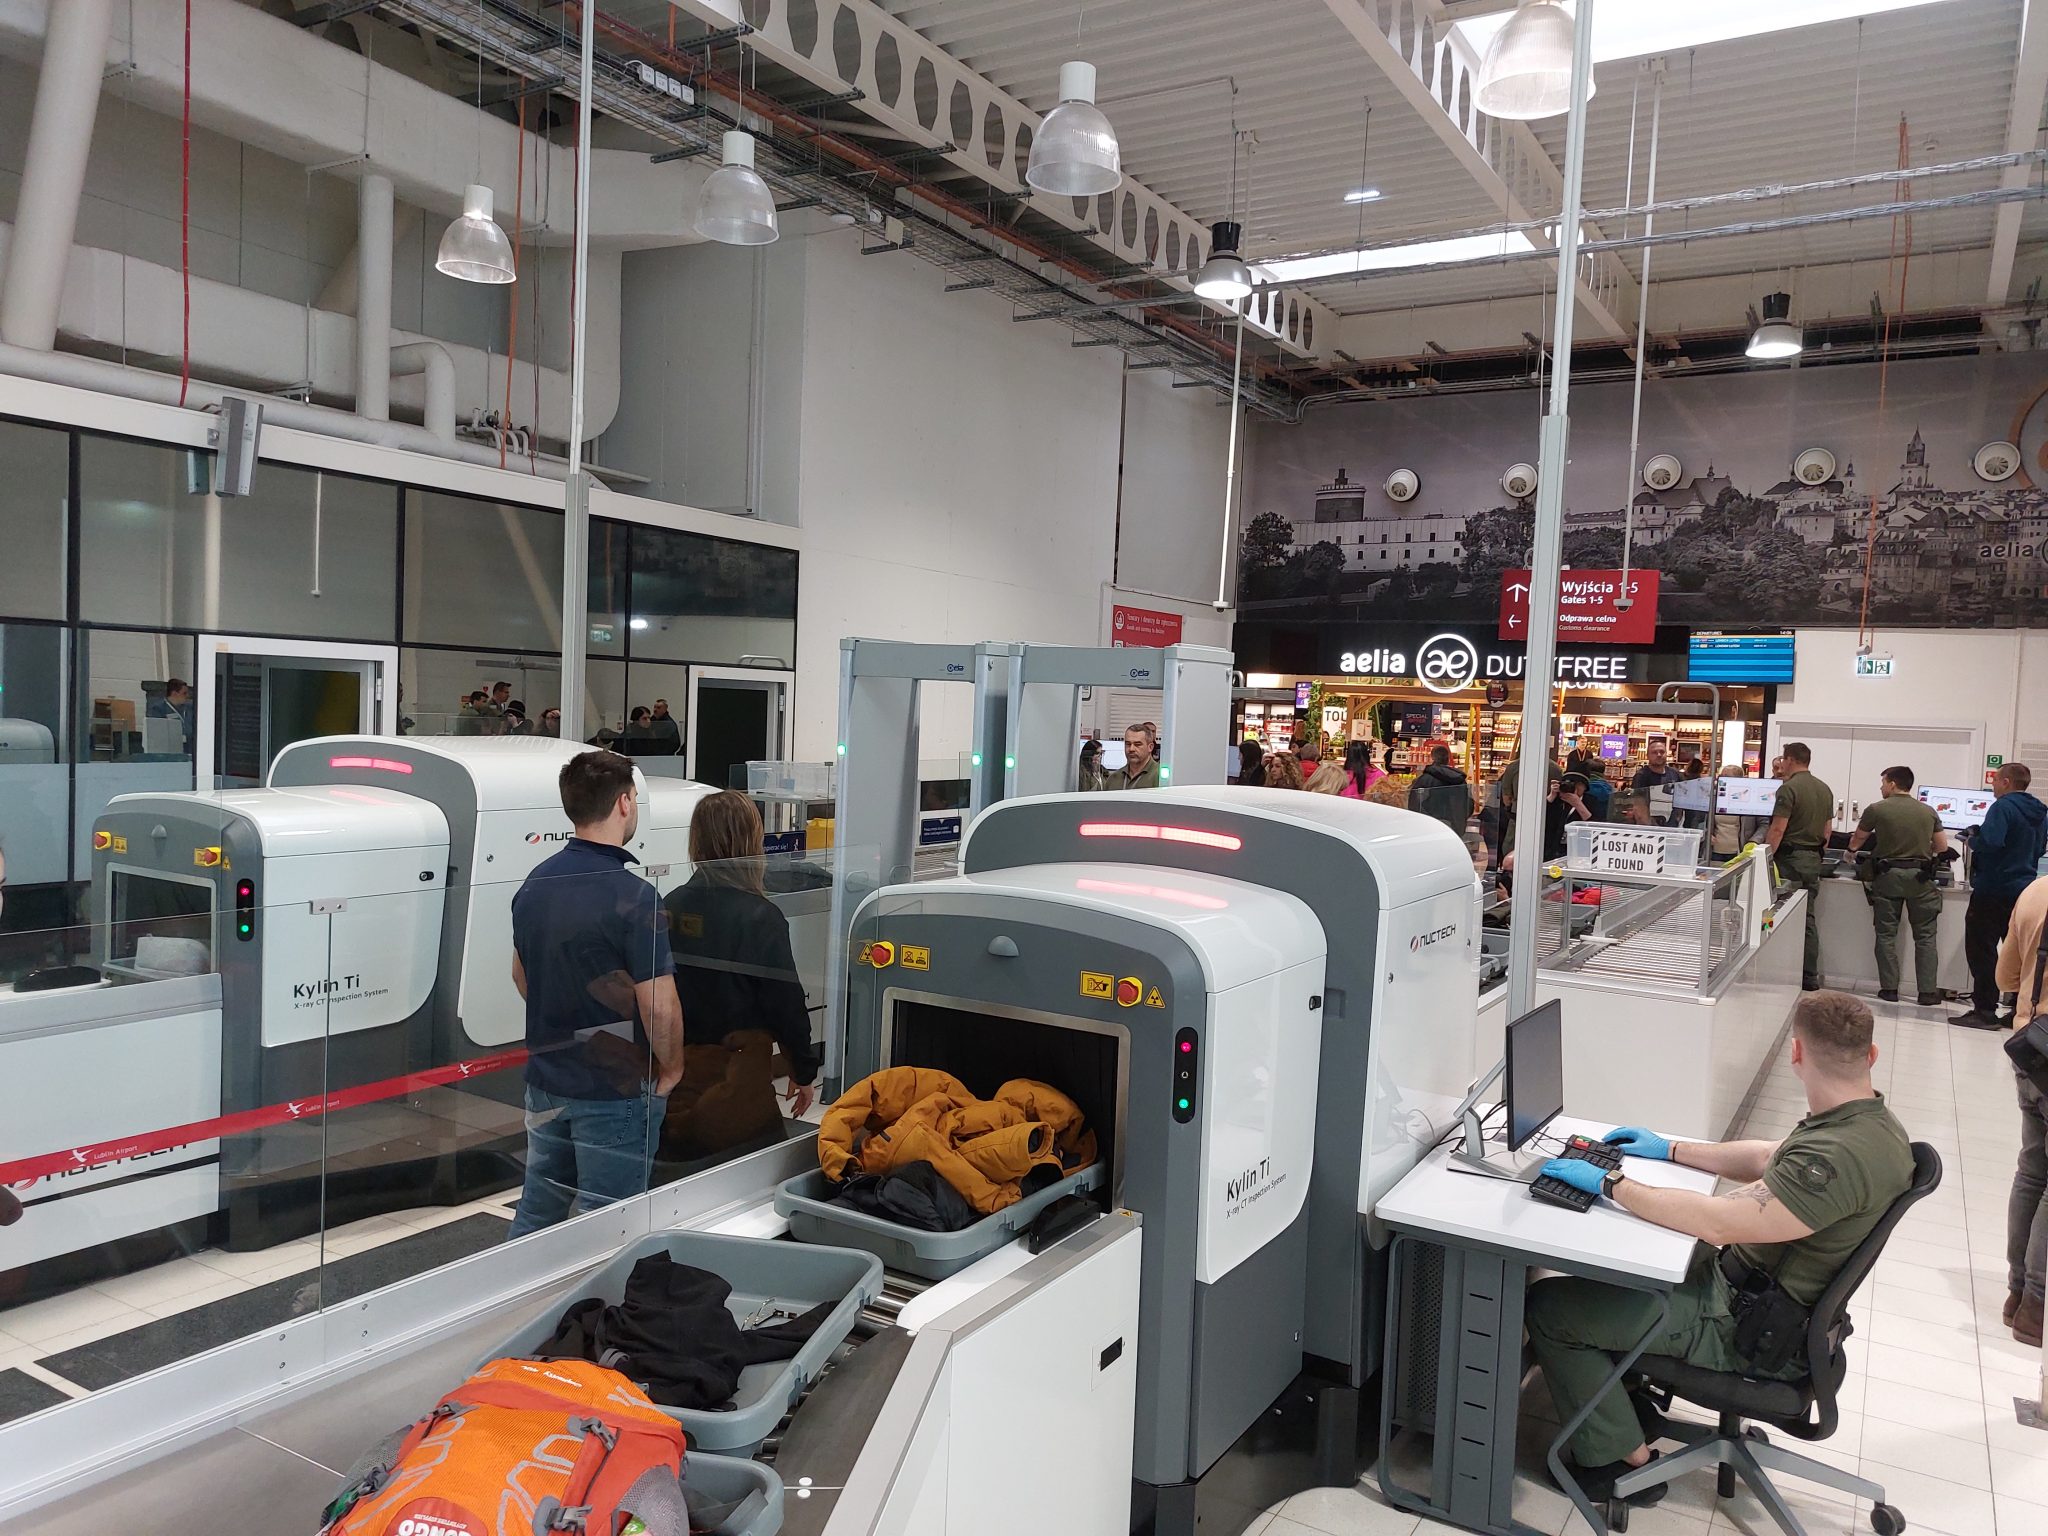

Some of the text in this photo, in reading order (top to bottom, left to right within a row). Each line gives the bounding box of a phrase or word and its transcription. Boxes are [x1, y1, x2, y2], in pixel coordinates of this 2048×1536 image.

[1980, 541, 2034, 558] aelia
[1561, 580, 1614, 596] Wyjścia
[1560, 595, 1604, 605] Gates 1-5
[1559, 614, 1617, 624] Odprawa celna
[1340, 648, 1406, 674] aelia
[1601, 840, 1654, 855] LOST AND
[1608, 857, 1644, 871] FOUND
[1419, 923, 1457, 948] NUCTECH
[293, 973, 360, 1000] Kylin Ti
[294, 988, 389, 1009] X-ray CT nspection System
[93, 1145, 138, 1160] Lublin Airport
[1226, 1155, 1270, 1202] Kylin Ti
